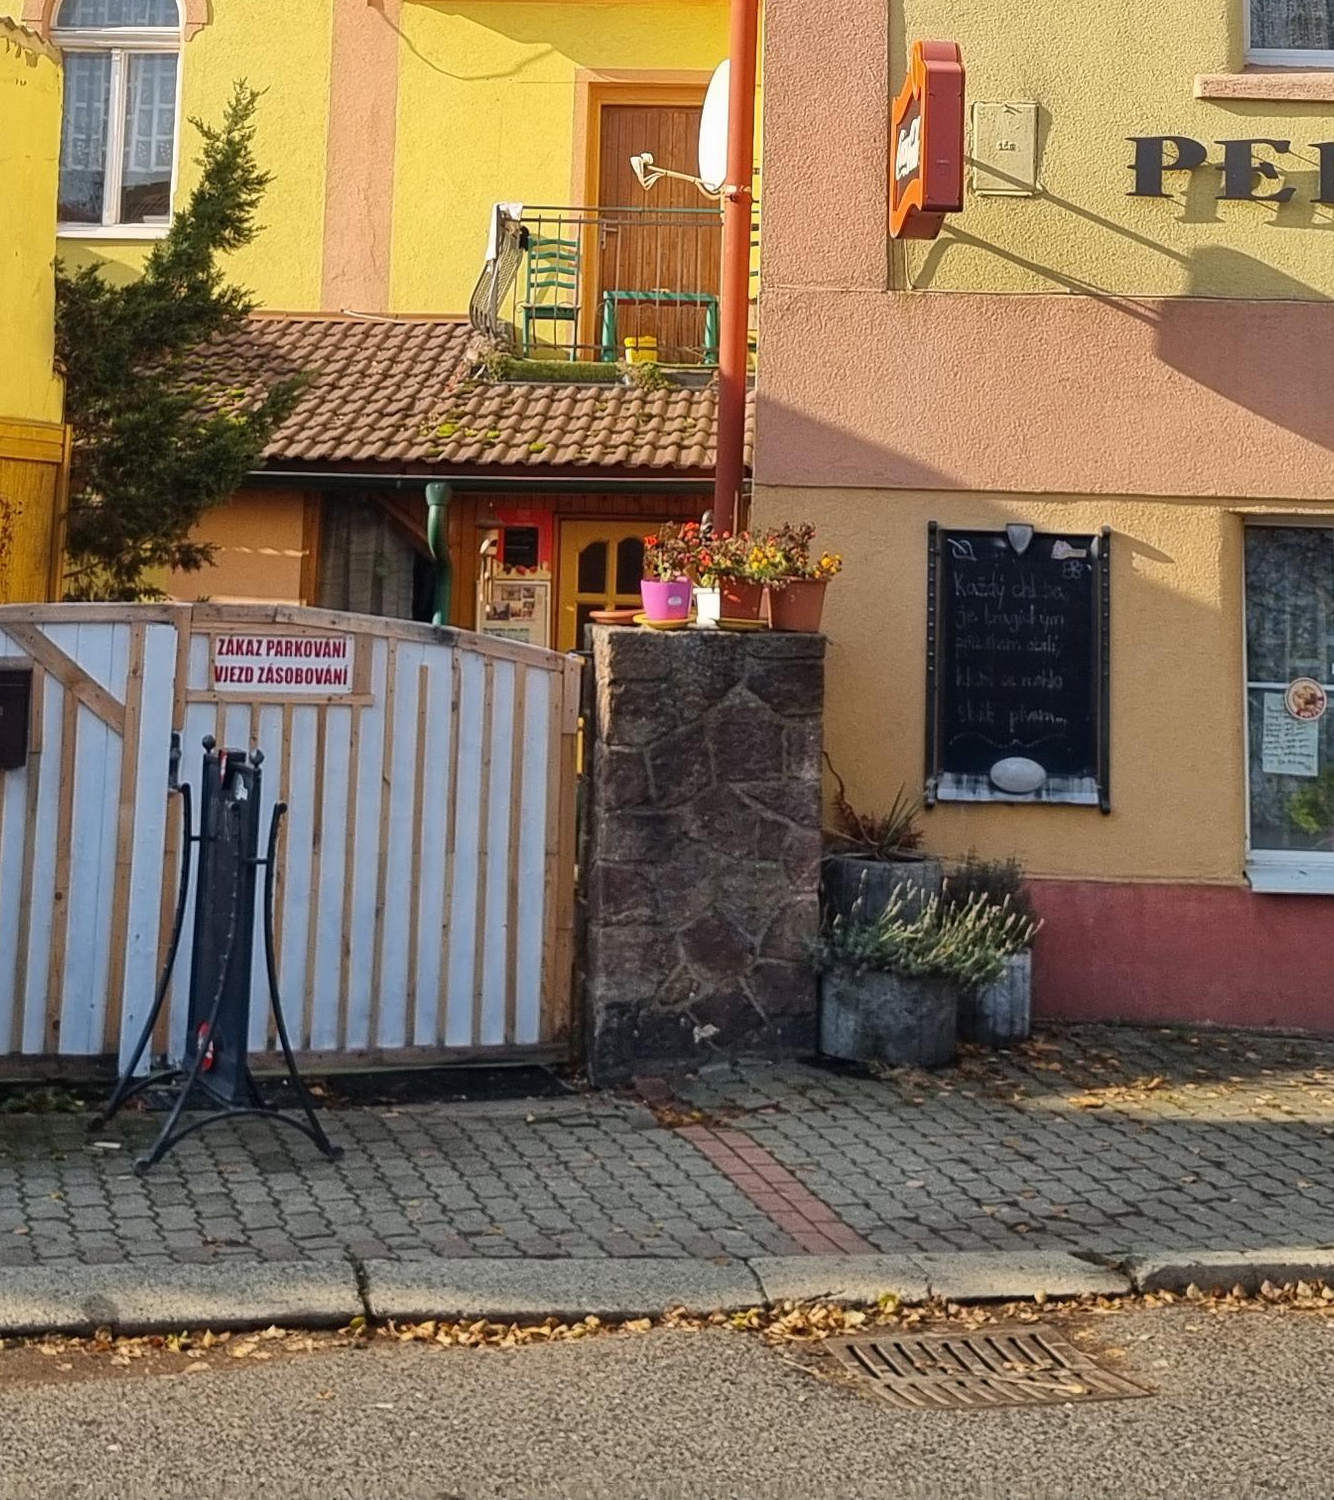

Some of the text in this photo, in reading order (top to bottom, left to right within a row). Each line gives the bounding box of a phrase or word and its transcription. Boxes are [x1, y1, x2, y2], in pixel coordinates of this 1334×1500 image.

[217, 635, 347, 658] ZÁKAZ PARKOVÁNÍ
[214, 662, 349, 685] VJEZD ZÁSOBOVÁNÍ
